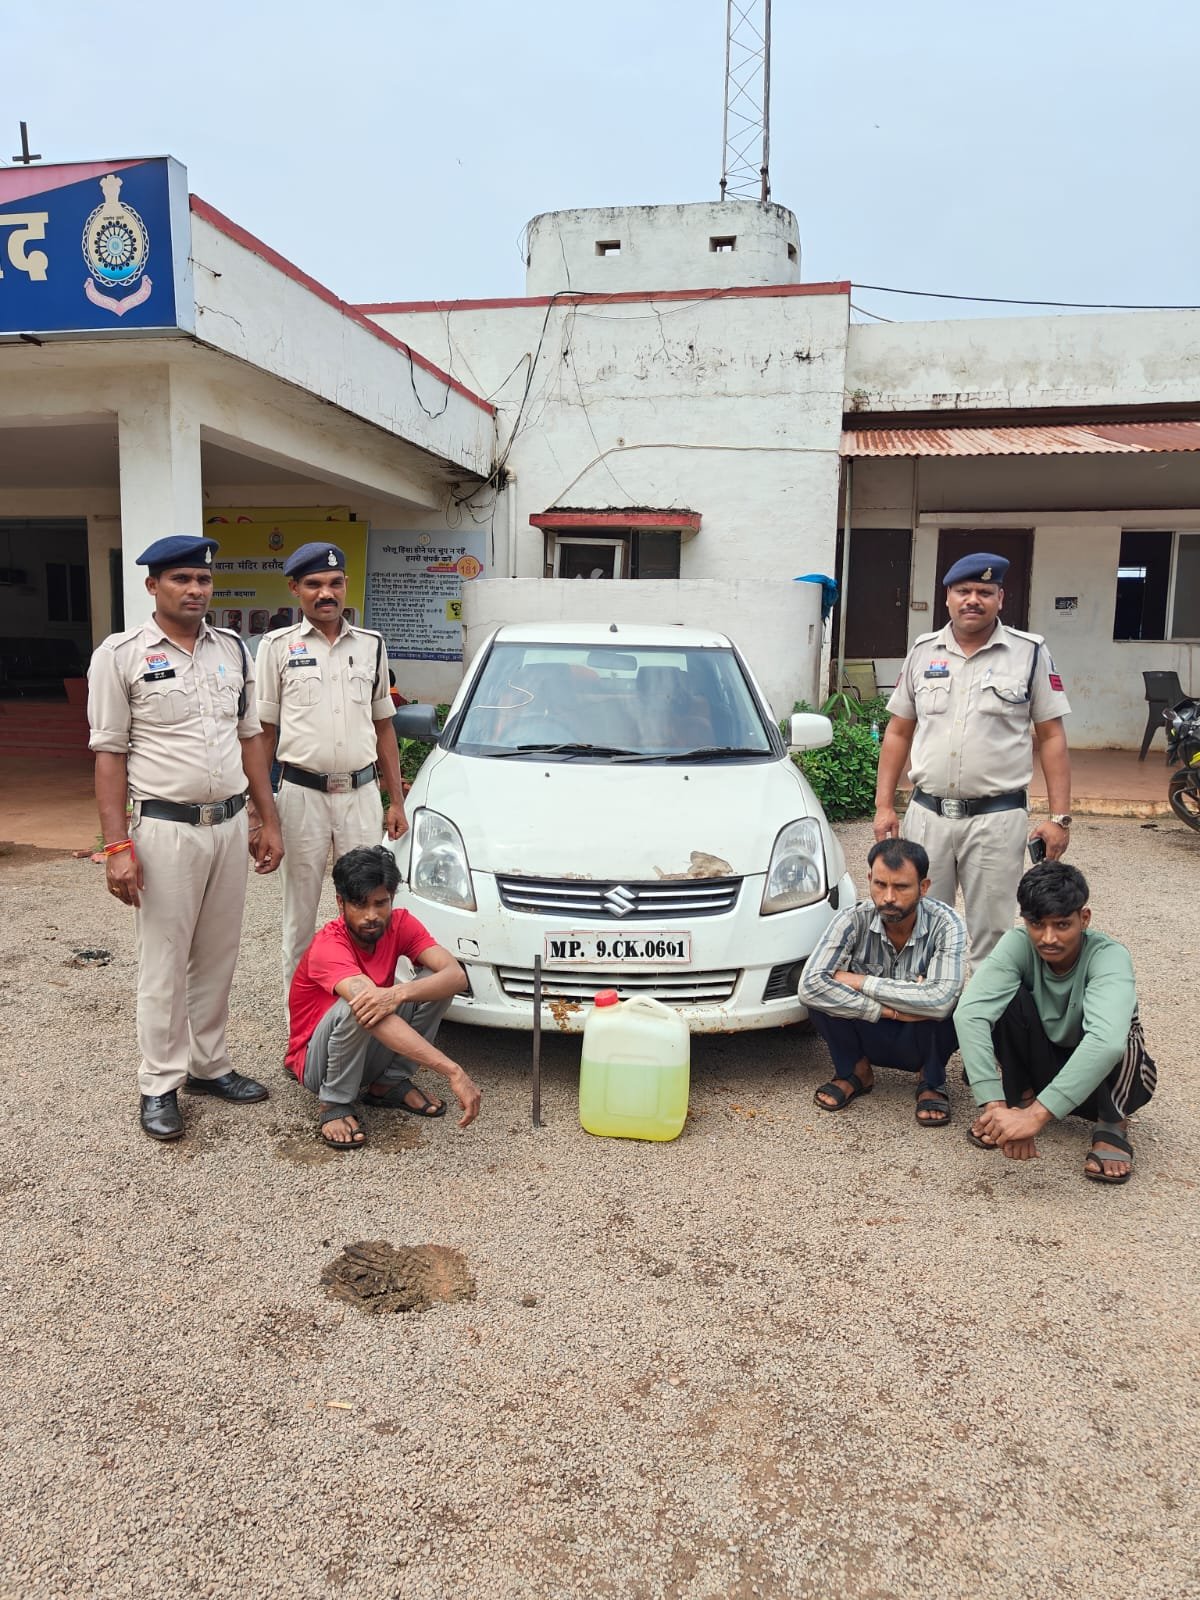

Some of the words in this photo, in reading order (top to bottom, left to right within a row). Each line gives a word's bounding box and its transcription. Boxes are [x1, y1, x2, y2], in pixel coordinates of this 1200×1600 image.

[238, 560, 257, 570] मंदिर
[460, 564, 477, 574] 181
[550, 940, 585, 958] MP.
